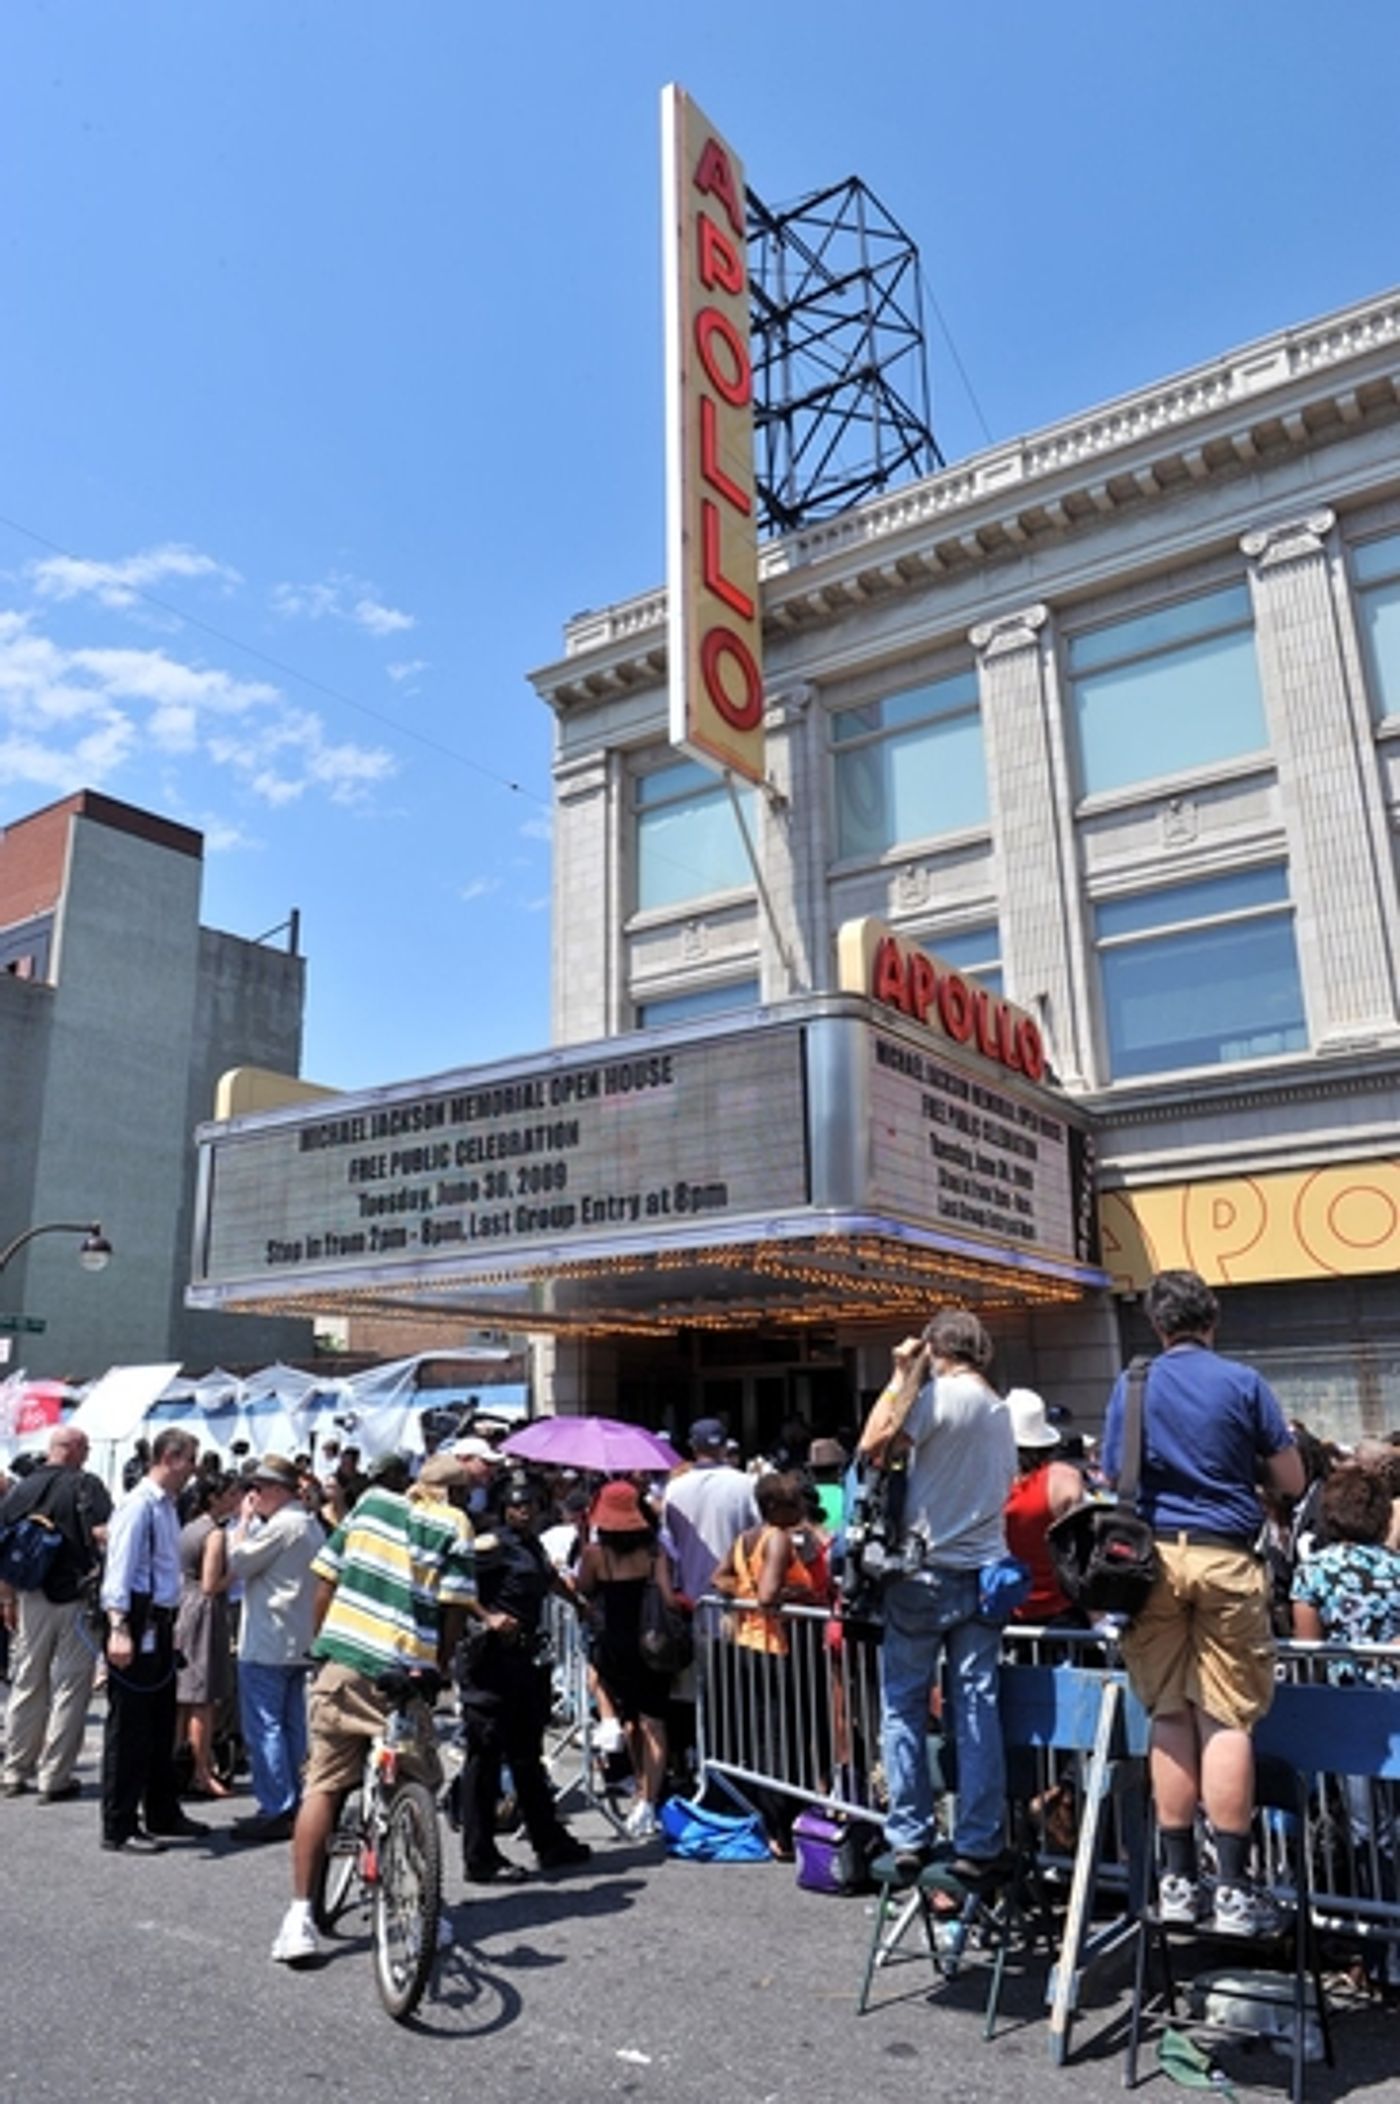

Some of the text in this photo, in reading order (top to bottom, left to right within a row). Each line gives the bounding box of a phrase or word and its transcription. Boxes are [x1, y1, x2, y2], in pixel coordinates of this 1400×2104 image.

[694, 137, 765, 733] APOLLO
[875, 936, 1044, 1081] APOLLO
[299, 1055, 673, 1152] MICHAEL JACKSON MEMORIAL OPEN HOUSE
[348, 1120, 579, 1184] FREE PUBLIC CELEBRATION
[517, 1160, 567, 1195] 2009
[470, 1210, 510, 1239] Last
[515, 1202, 576, 1233] Group
[581, 1192, 640, 1225] Entry
[646, 1187, 670, 1217] at
